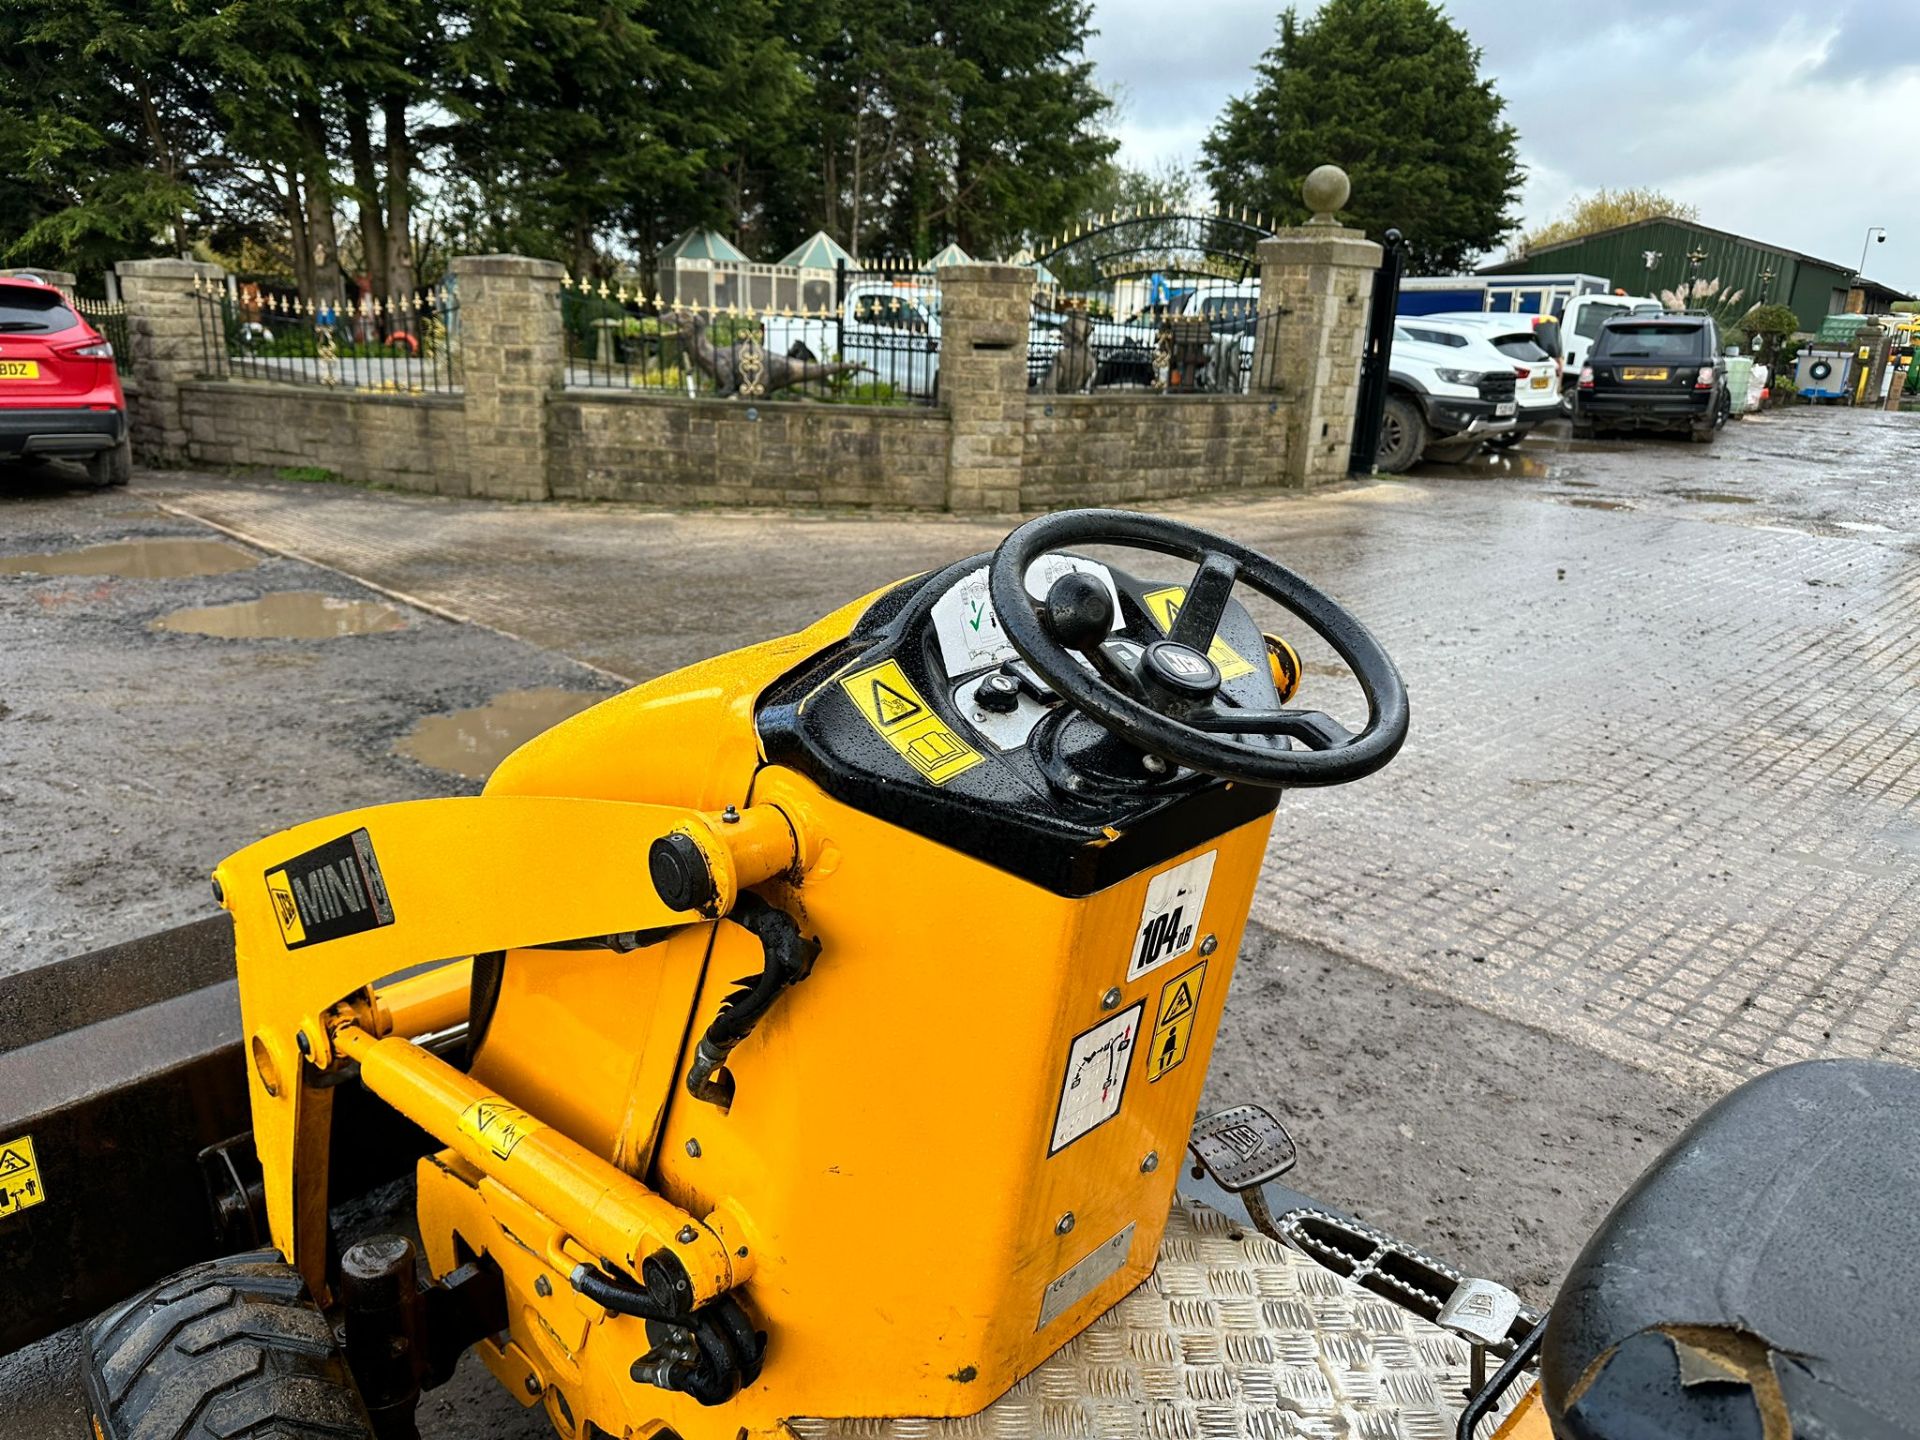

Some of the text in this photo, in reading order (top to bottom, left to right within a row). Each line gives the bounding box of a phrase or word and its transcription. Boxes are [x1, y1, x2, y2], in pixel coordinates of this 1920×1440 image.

[274, 891, 297, 926] JCB
[292, 856, 367, 926] MINI
[1136, 905, 1193, 970] 104 dB
[1222, 1127, 1258, 1154] JCB
